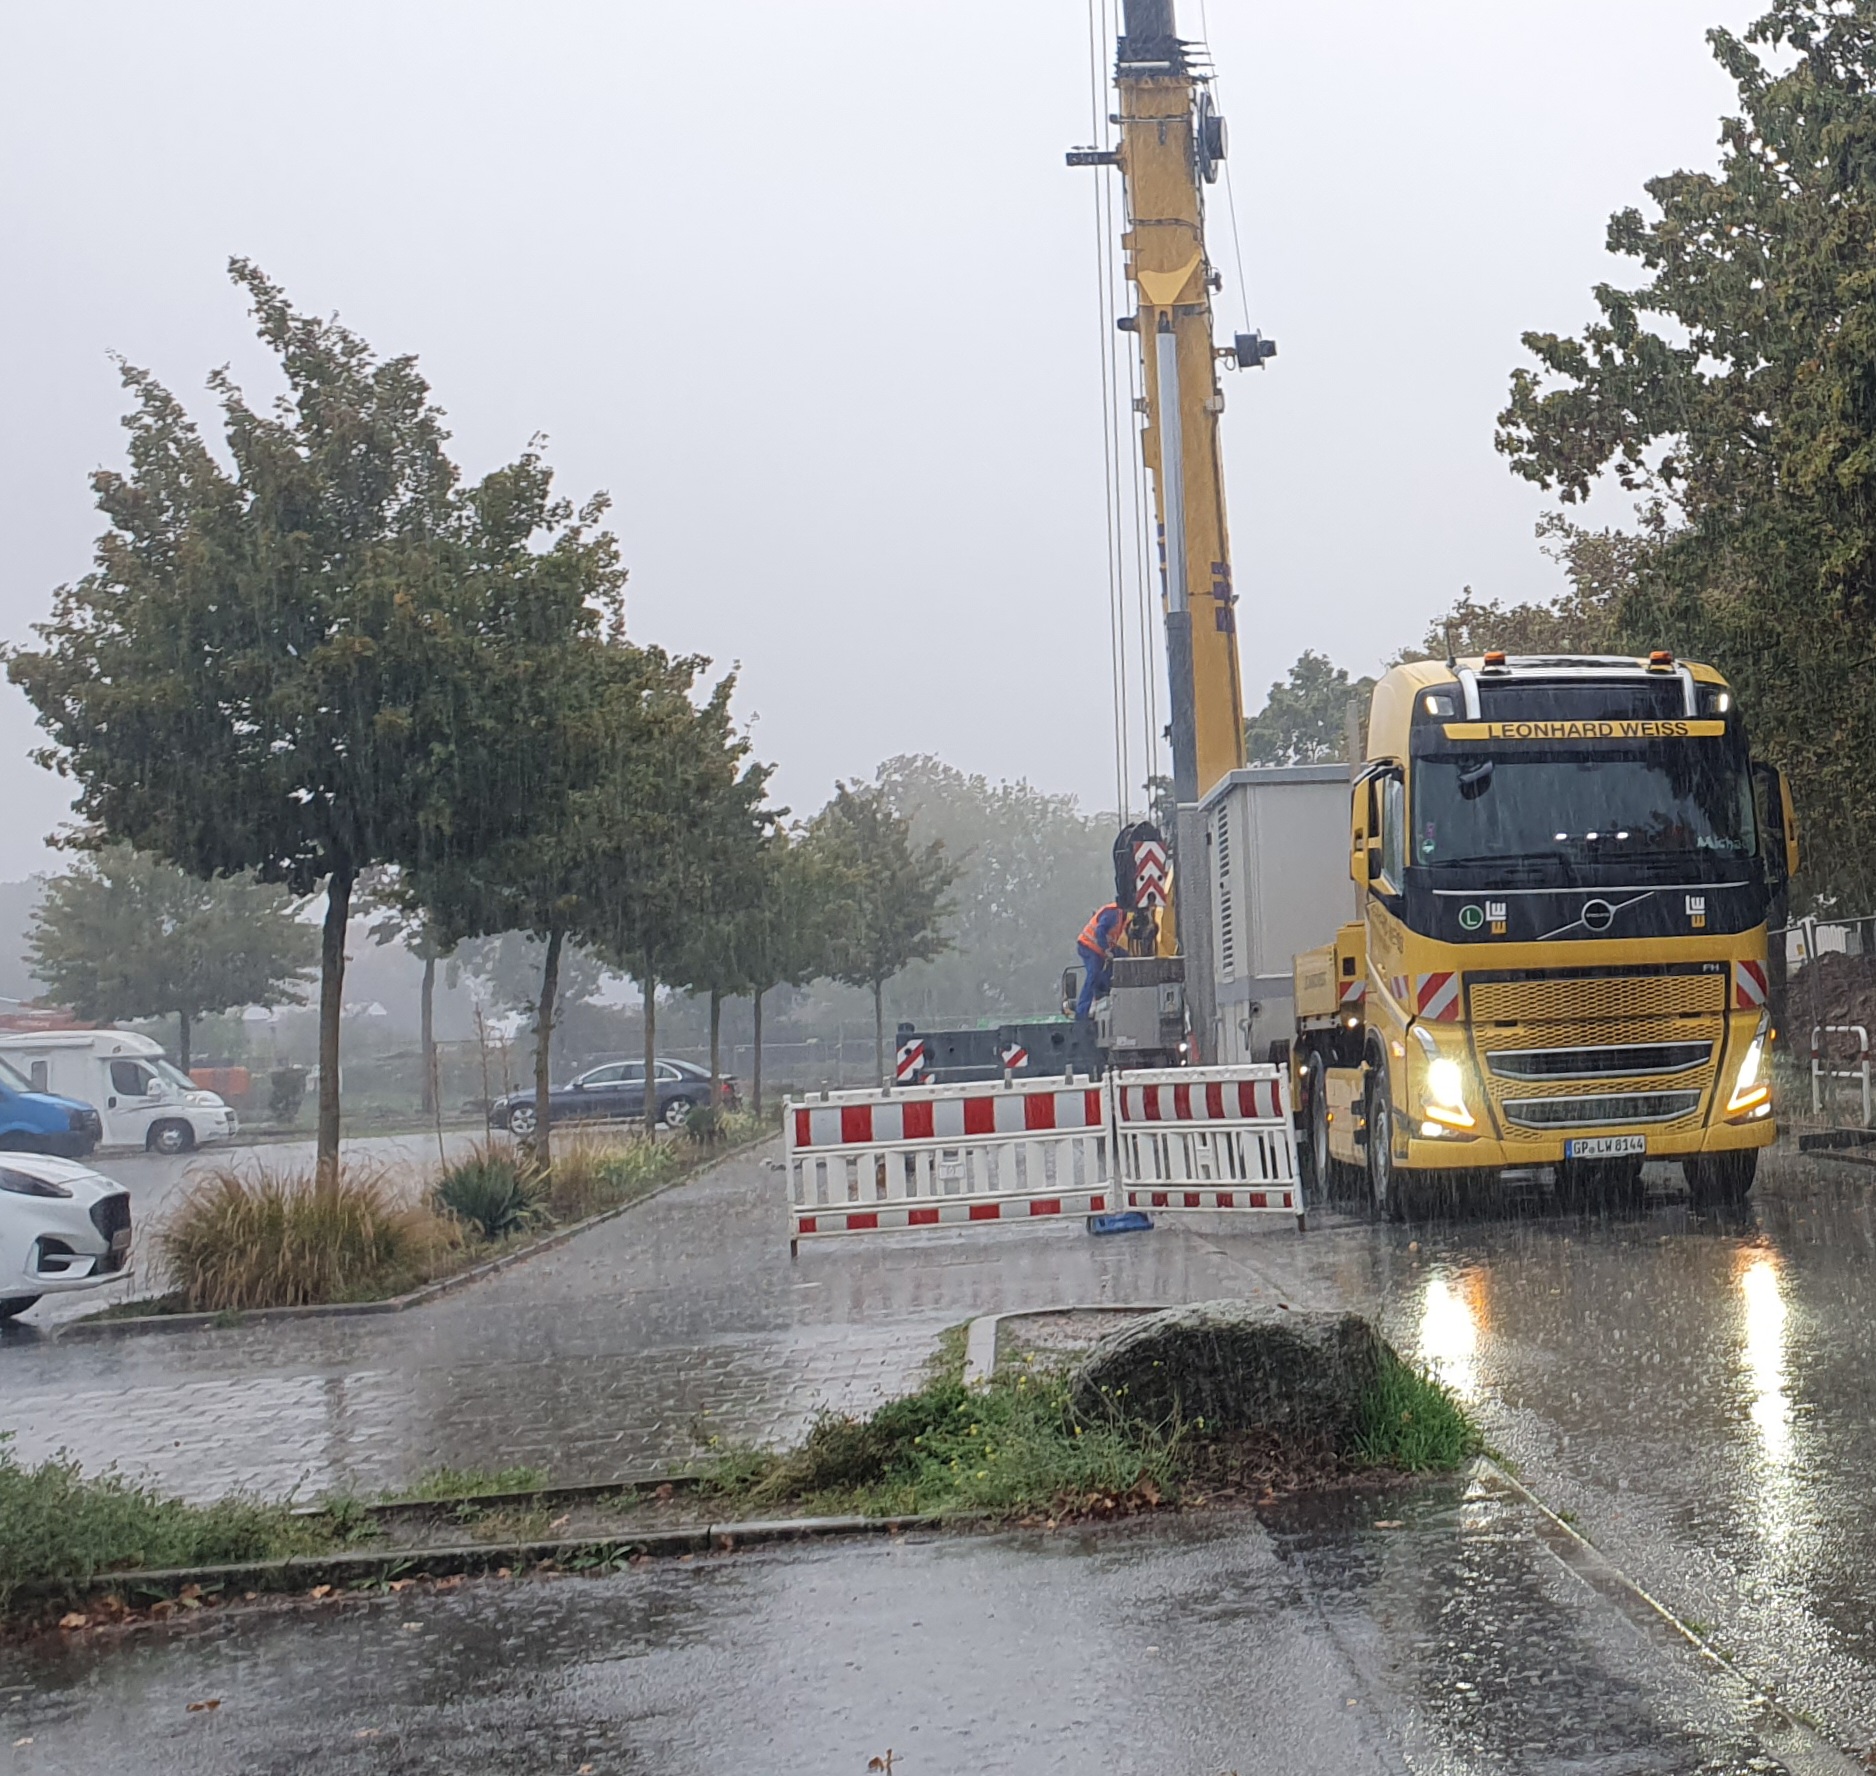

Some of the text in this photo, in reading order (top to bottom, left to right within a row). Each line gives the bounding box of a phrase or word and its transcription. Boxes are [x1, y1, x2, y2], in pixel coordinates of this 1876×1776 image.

[1488, 722, 1689, 739] LEONHARD WEISS
[1466, 910, 1478, 926] L
[1573, 1138, 1644, 1154] GP LW 8144
